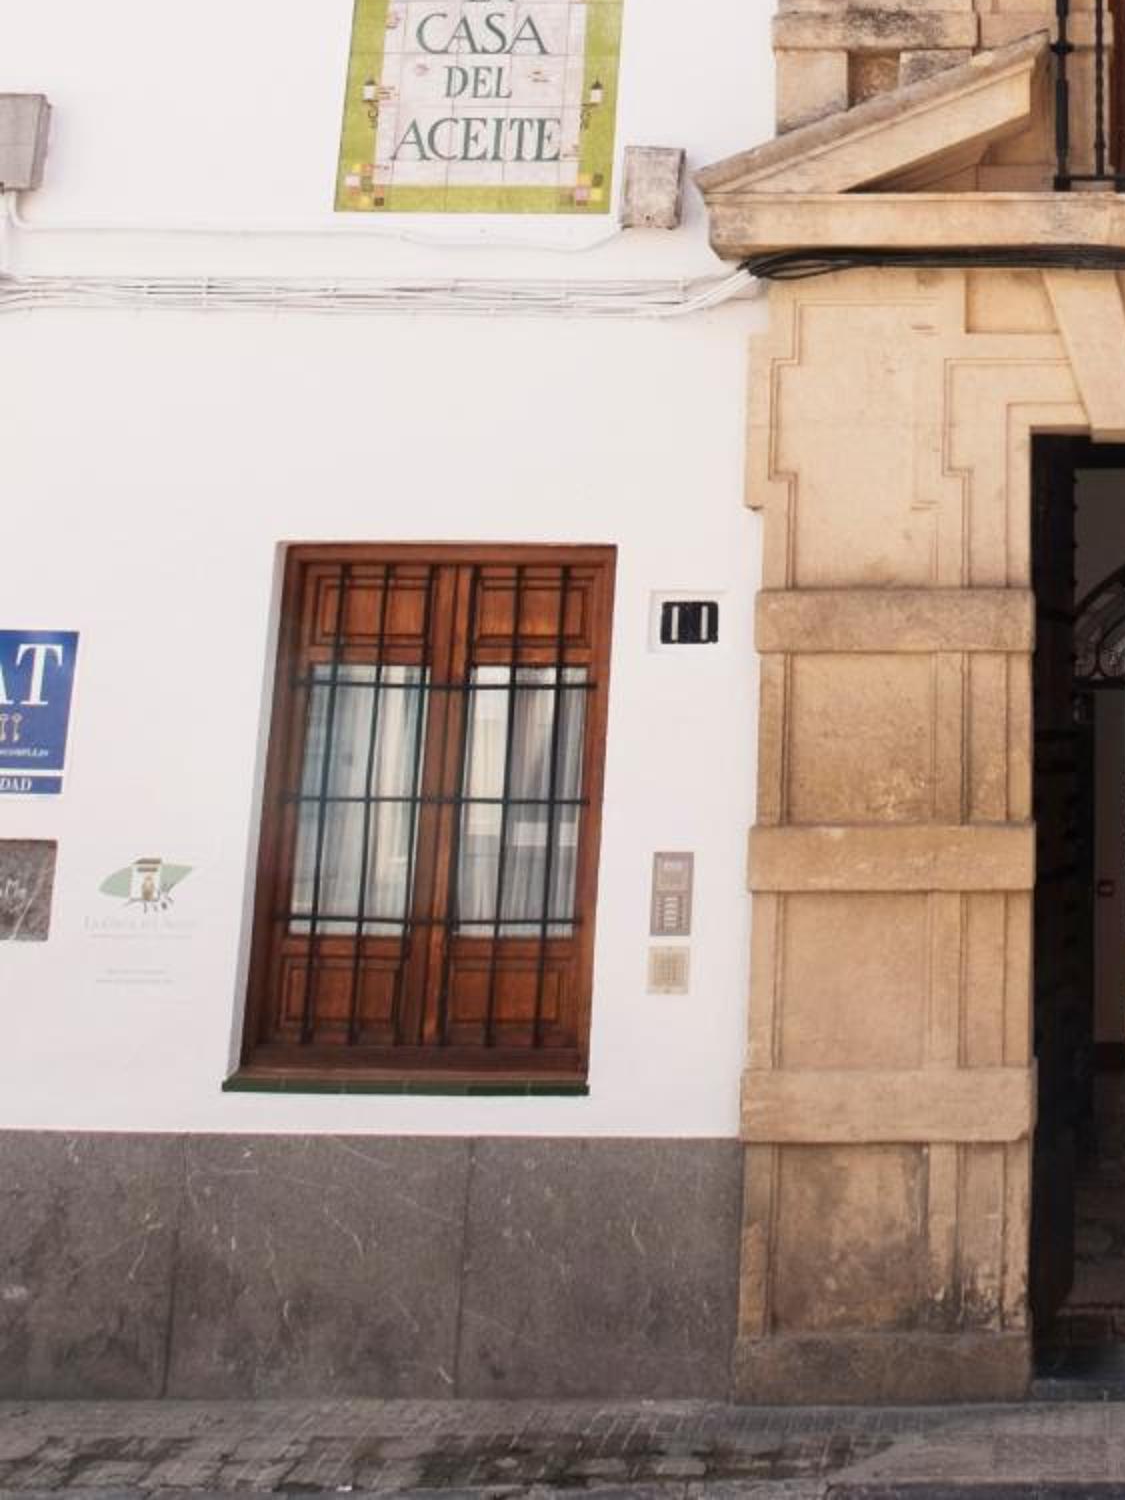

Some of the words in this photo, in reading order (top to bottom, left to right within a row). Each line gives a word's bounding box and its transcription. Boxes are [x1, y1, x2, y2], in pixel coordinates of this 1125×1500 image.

[415, 12, 550, 55] CASA
[444, 66, 512, 99] DEL
[389, 117, 562, 162] ACEITE
